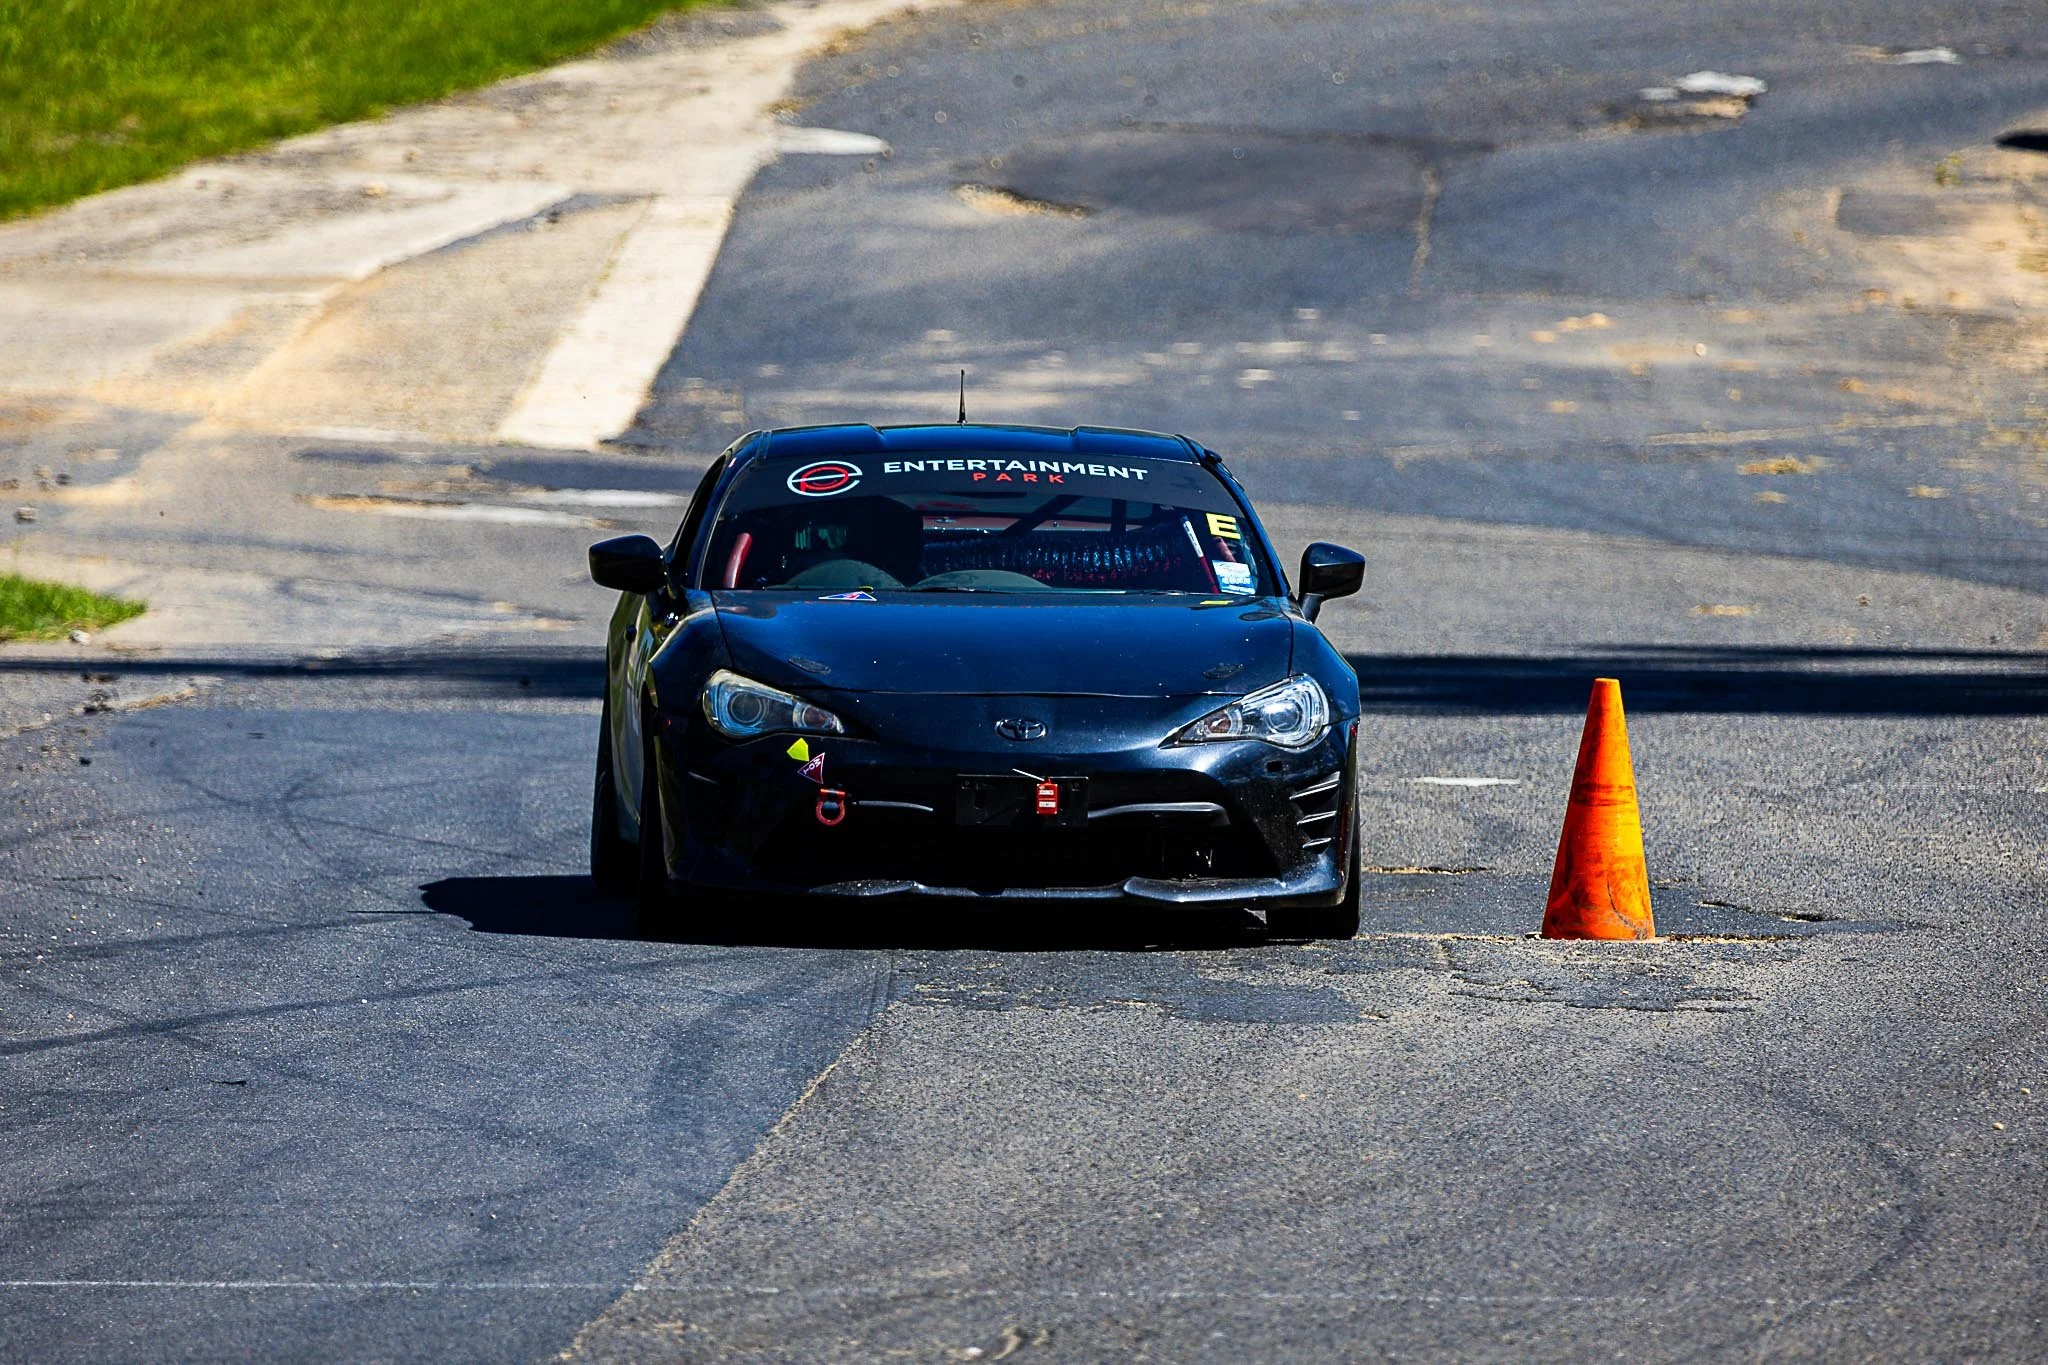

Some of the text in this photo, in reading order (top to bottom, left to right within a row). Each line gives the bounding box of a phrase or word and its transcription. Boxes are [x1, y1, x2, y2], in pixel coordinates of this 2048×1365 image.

[884, 459, 1148, 480] ENTERTAINMENT
[973, 472, 1065, 484] PARK
[1206, 513, 1241, 540] E
[803, 758, 821, 775] TOW
